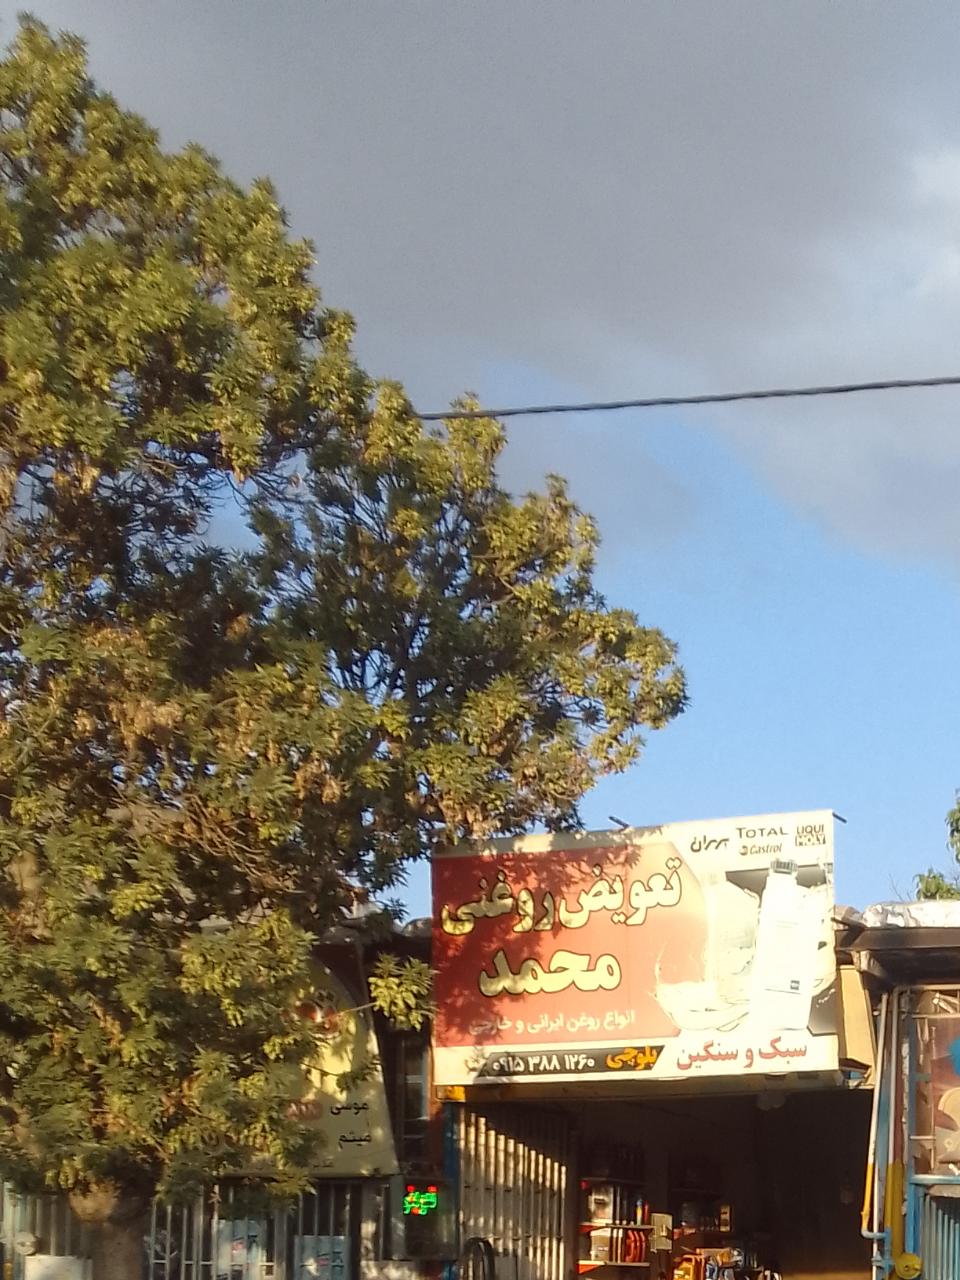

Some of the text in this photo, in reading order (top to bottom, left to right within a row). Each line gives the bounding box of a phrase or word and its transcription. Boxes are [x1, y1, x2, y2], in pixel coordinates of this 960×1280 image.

[736, 826, 789, 839] TOTAL
[796, 824, 825, 839] LIQUI
[749, 844, 783, 856] Castrol
[440, 857, 682, 936] تعویض روغنی
[479, 949, 622, 997] محمد
[515, 1019, 526, 1034] و
[527, 1013, 565, 1034] ایرانی
[566, 1015, 601, 1032] روغن
[603, 1010, 636, 1030] انواع
[492, 1045, 657, 1073] بلوچی ۰۹۱۵ ۳۸۸ ۱۲۶۰
[743, 1047, 754, 1069] و
[759, 1036, 808, 1065] سبک
